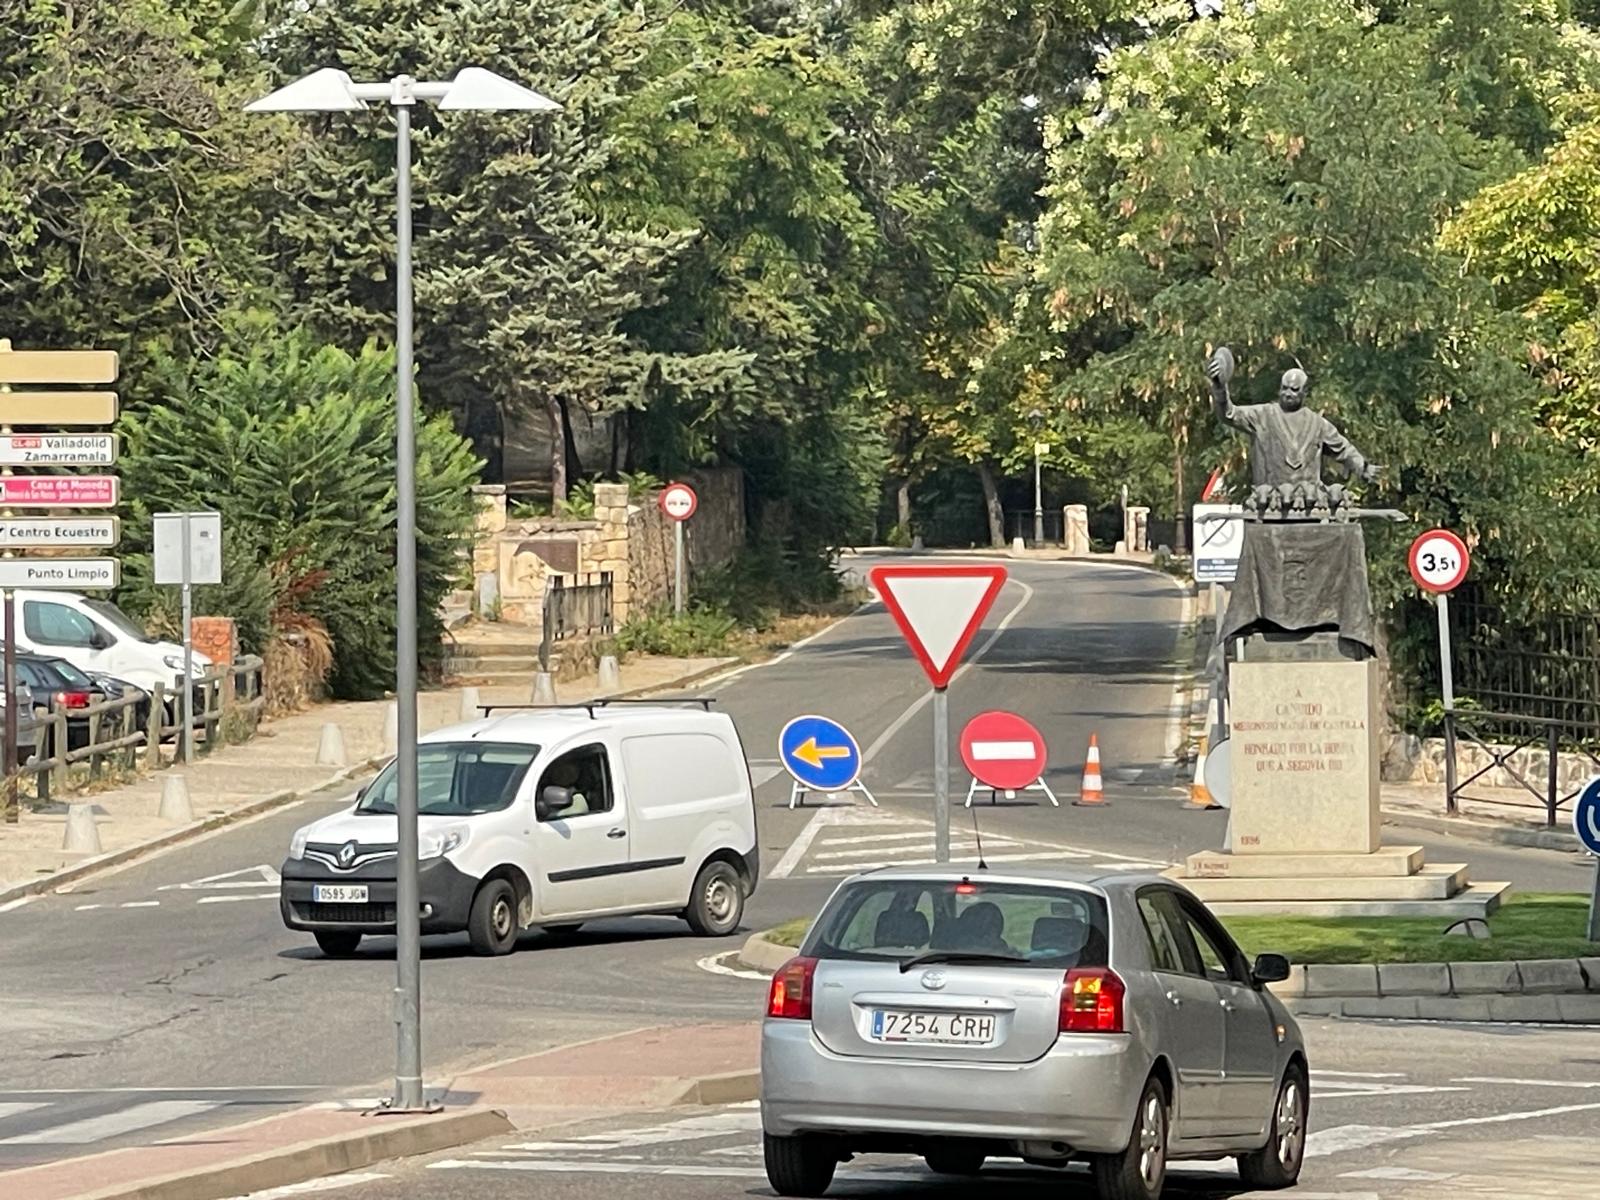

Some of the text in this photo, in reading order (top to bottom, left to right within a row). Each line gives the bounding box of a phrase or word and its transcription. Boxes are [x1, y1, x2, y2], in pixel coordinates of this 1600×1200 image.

[46, 438, 107, 449] Valladolid
[25, 452, 107, 462] Zamarramala
[31, 480, 109, 490] Casa de Moneda
[10, 527, 109, 537] Centro Ecuestre
[28, 568, 109, 580] Punto Limpio
[1323, 720, 1365, 730] CASTILLA
[1276, 761, 1284, 771] A
[1286, 760, 1325, 771] SEGOVIA
[886, 1014, 991, 1038] 7254 CRH
